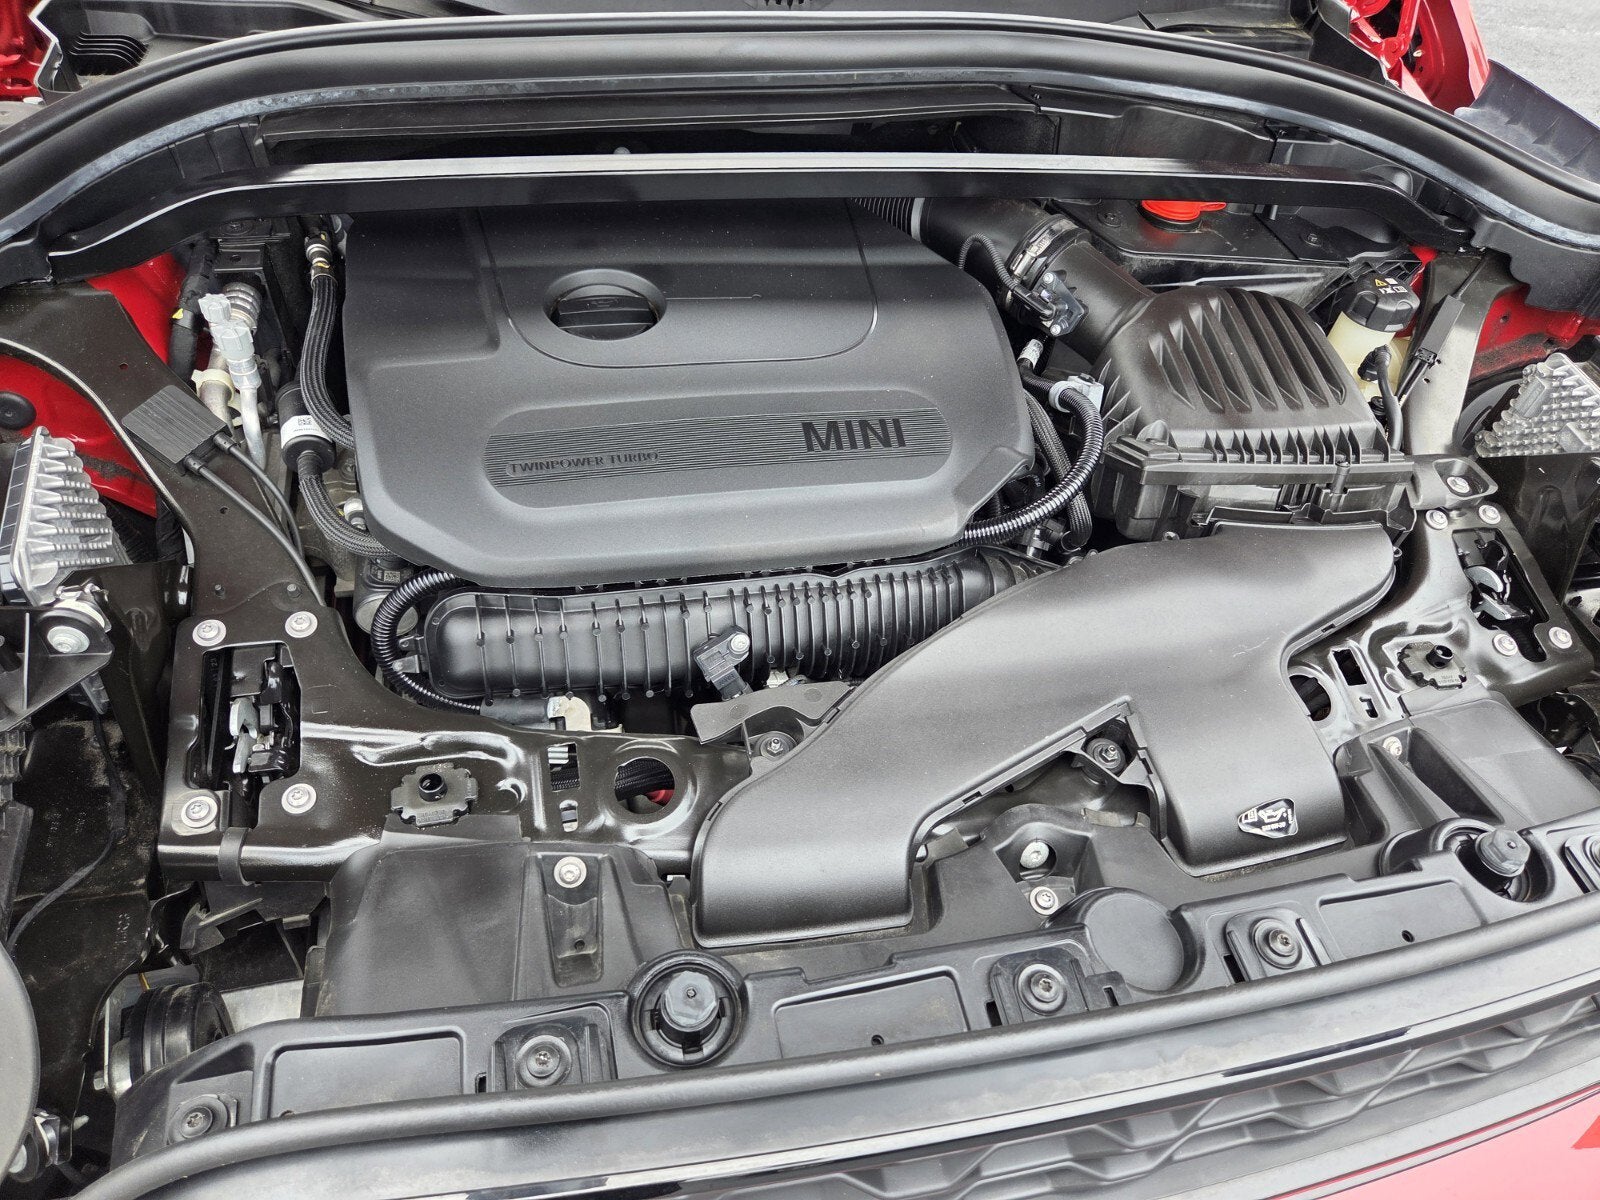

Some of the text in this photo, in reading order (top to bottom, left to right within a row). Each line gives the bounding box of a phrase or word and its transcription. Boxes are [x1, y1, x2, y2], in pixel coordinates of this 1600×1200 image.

[801, 418, 906, 452] MINI
[511, 451, 659, 473] TWINPOWER TURBO
